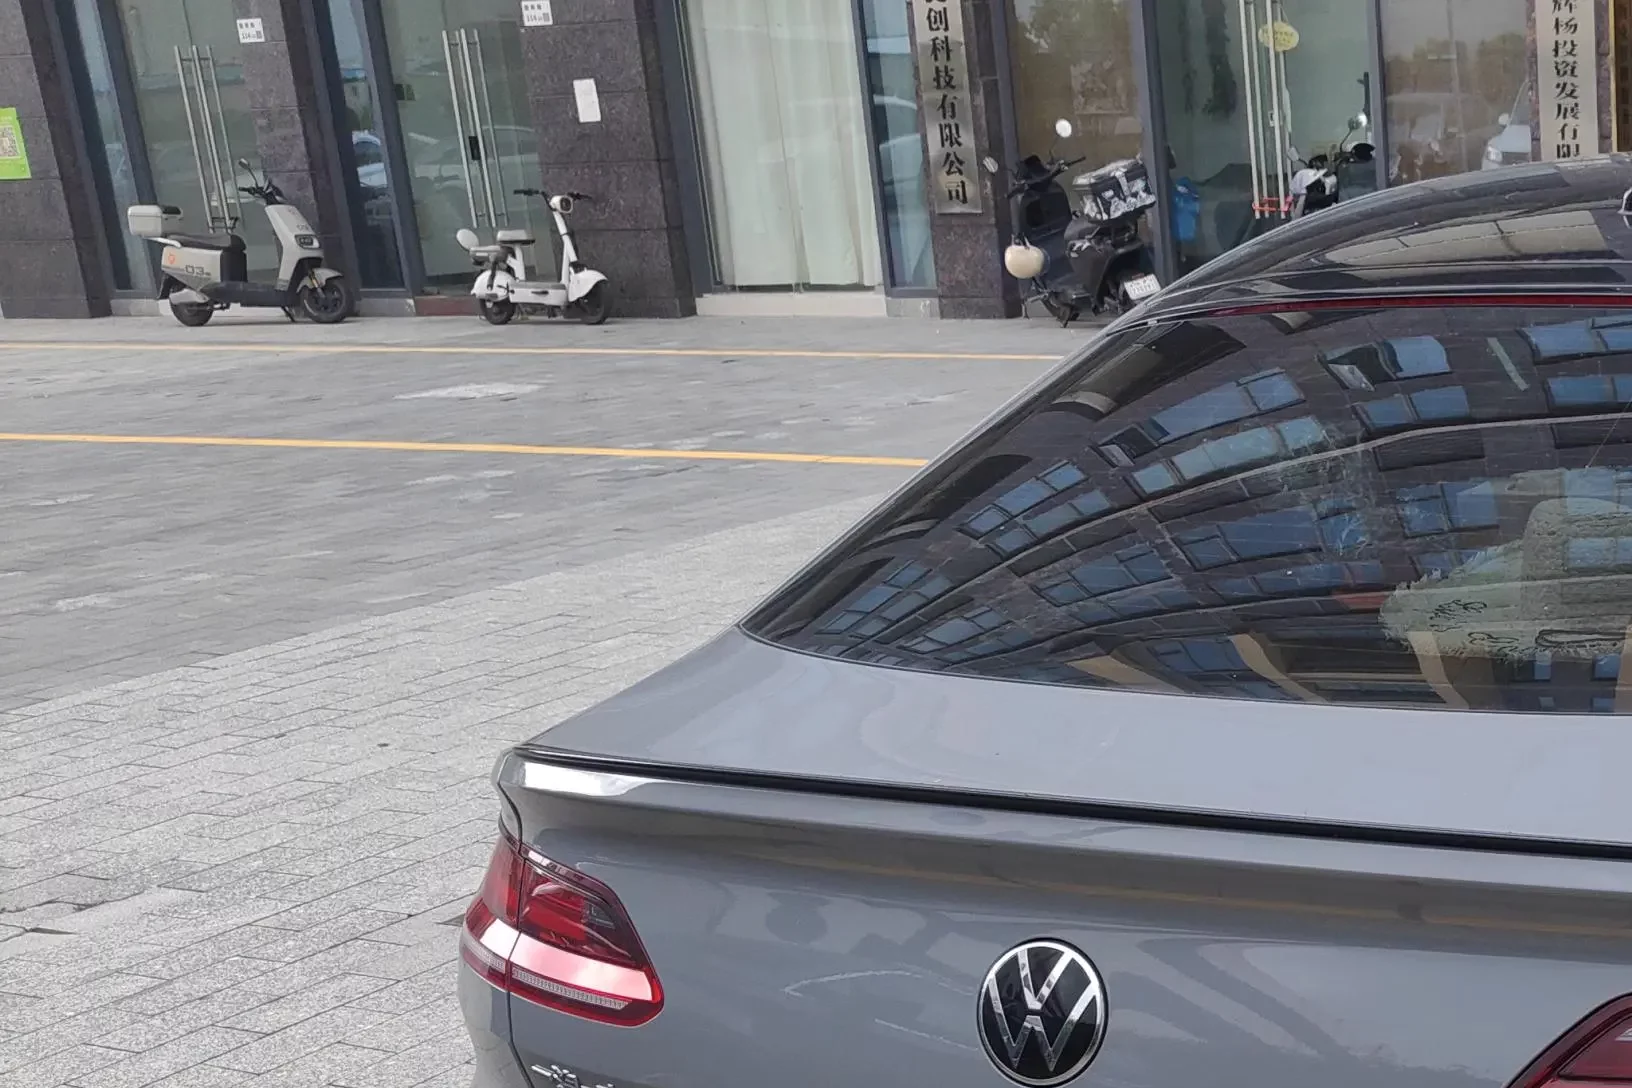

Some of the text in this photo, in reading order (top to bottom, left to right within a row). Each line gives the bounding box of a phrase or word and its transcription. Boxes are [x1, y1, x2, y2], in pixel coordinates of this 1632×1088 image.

[924, 0, 968, 204] 创科技有限公司
